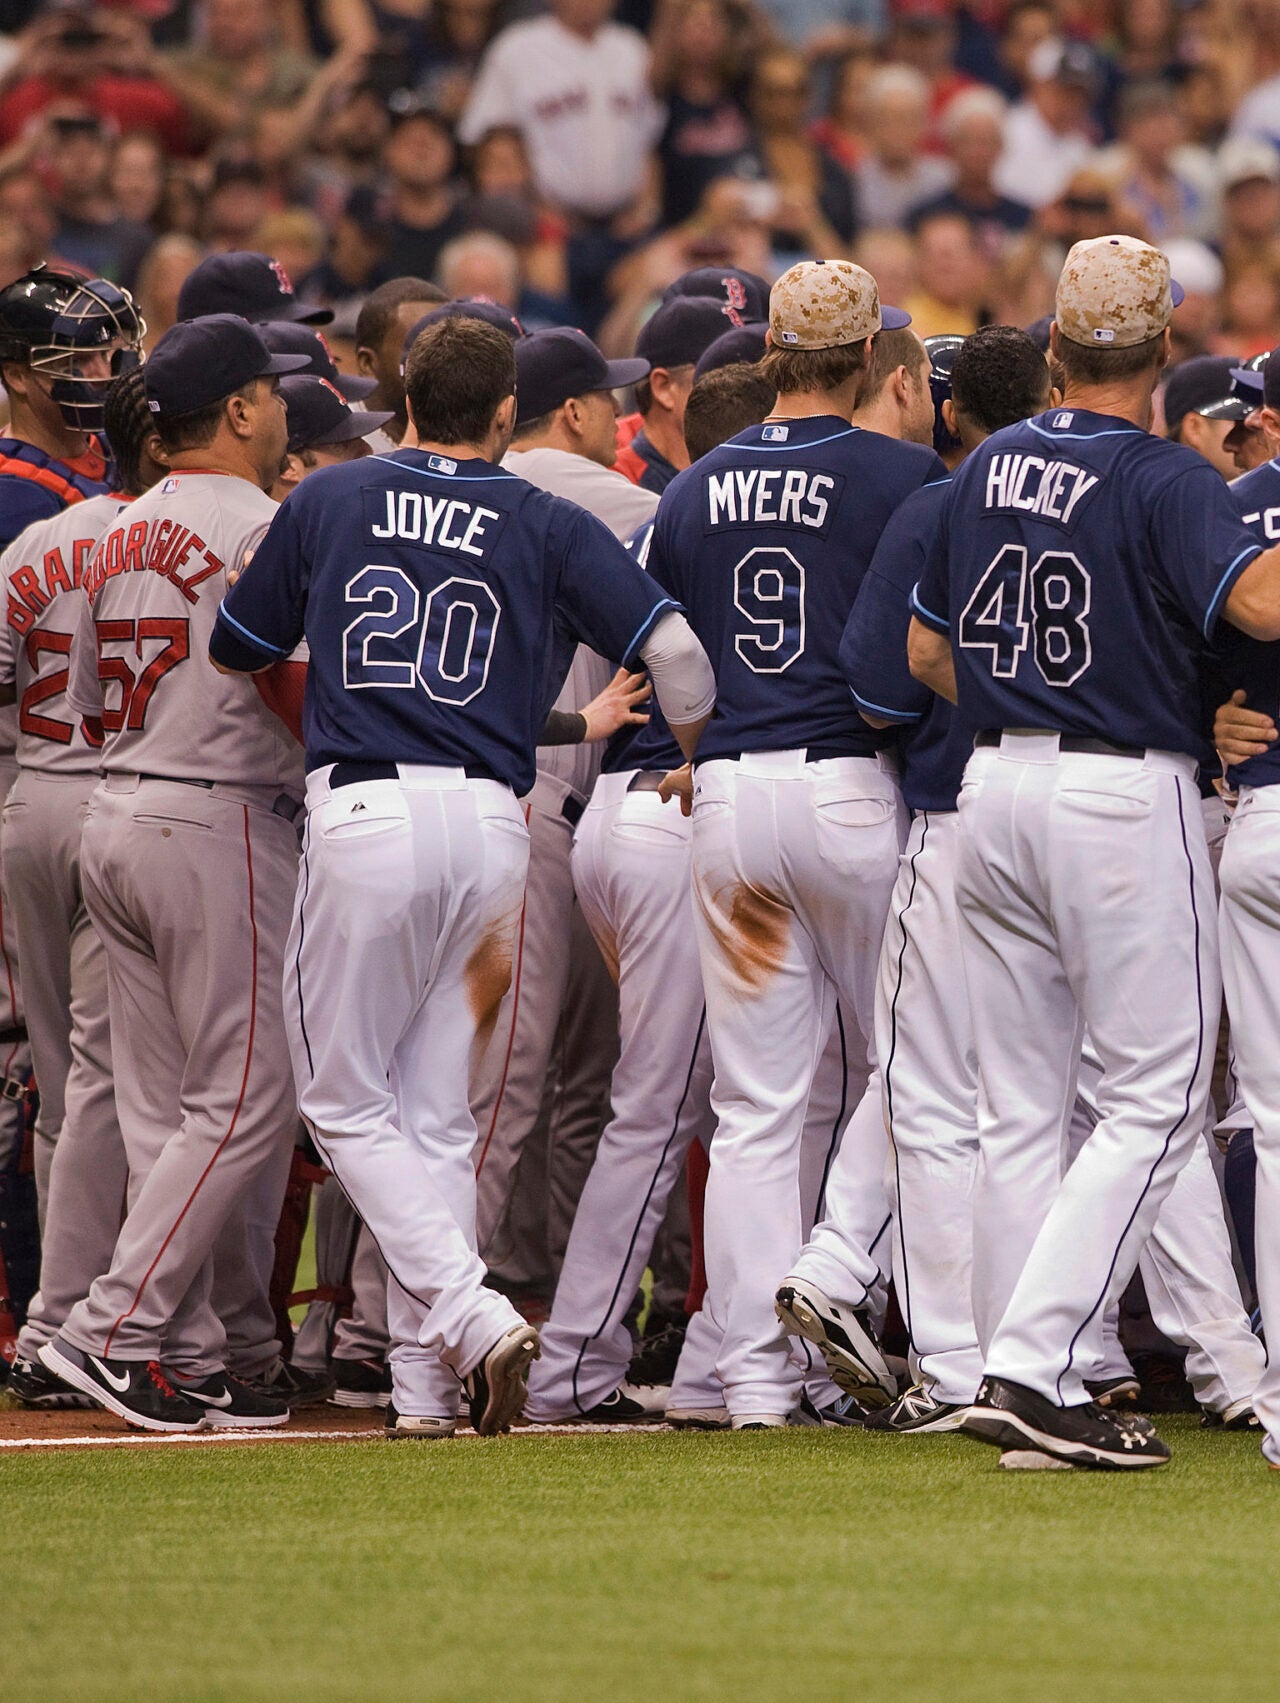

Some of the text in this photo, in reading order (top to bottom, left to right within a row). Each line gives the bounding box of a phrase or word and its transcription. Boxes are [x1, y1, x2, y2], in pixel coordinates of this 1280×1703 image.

[720, 277, 747, 310] B
[371, 490, 500, 557] JOYCE
[708, 469, 835, 528] MYERS
[985, 453, 1099, 524] HICKEY
[342, 564, 502, 707] 20
[733, 546, 806, 674] 9
[959, 543, 1092, 688] 48
[19, 628, 105, 748] 2
[95, 616, 191, 733] 57
